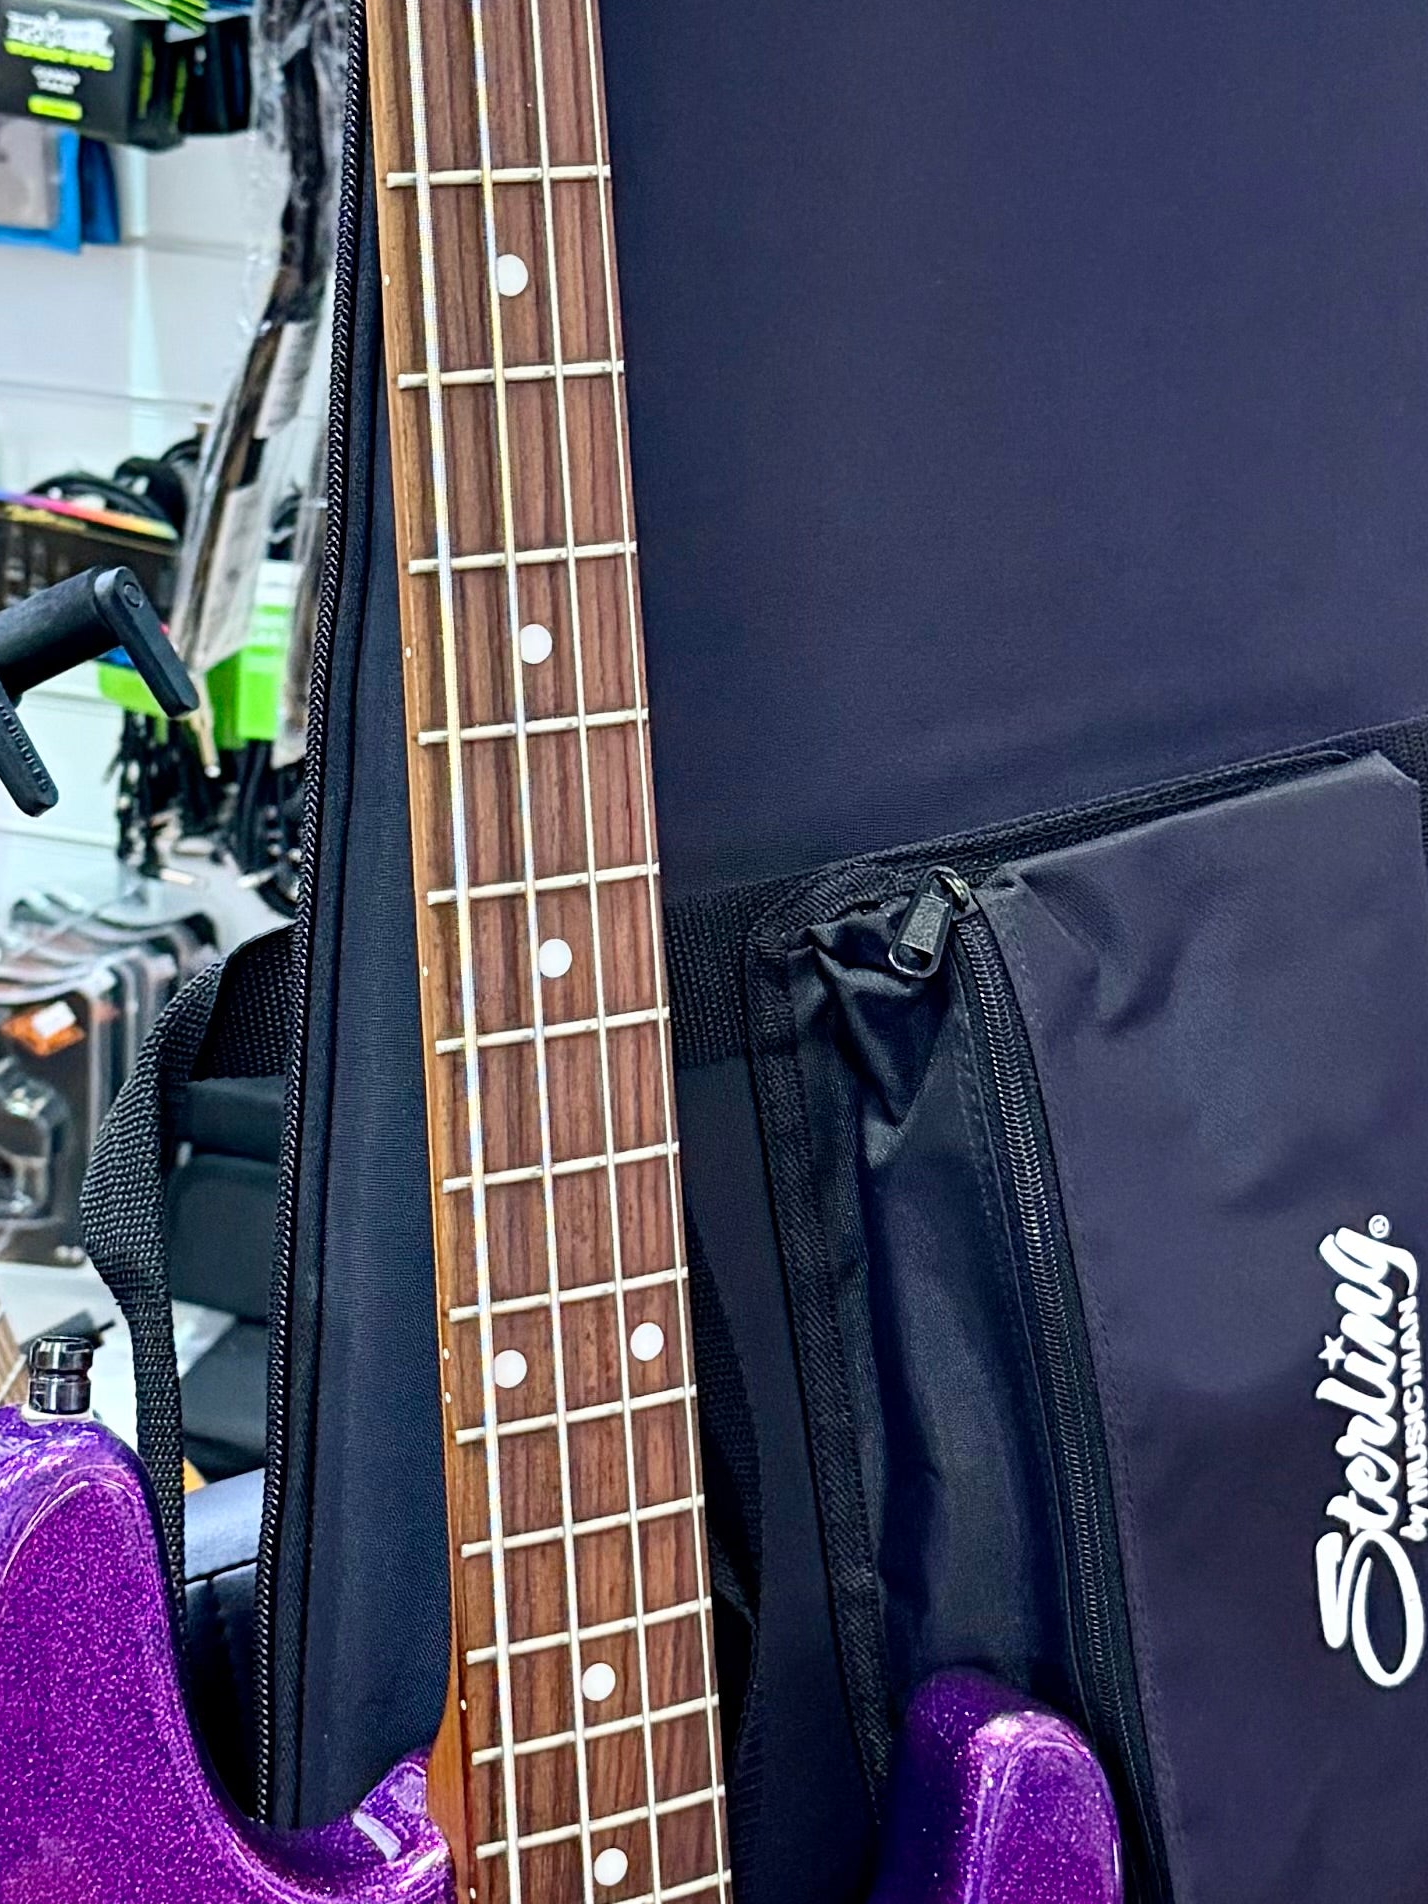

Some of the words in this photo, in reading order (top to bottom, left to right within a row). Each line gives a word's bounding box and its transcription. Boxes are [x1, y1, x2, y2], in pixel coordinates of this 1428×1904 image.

[1398, 1297, 1423, 1381] MAN
[1316, 1227, 1425, 1687] Sterling
[1402, 1385, 1428, 1503] MUSIC
